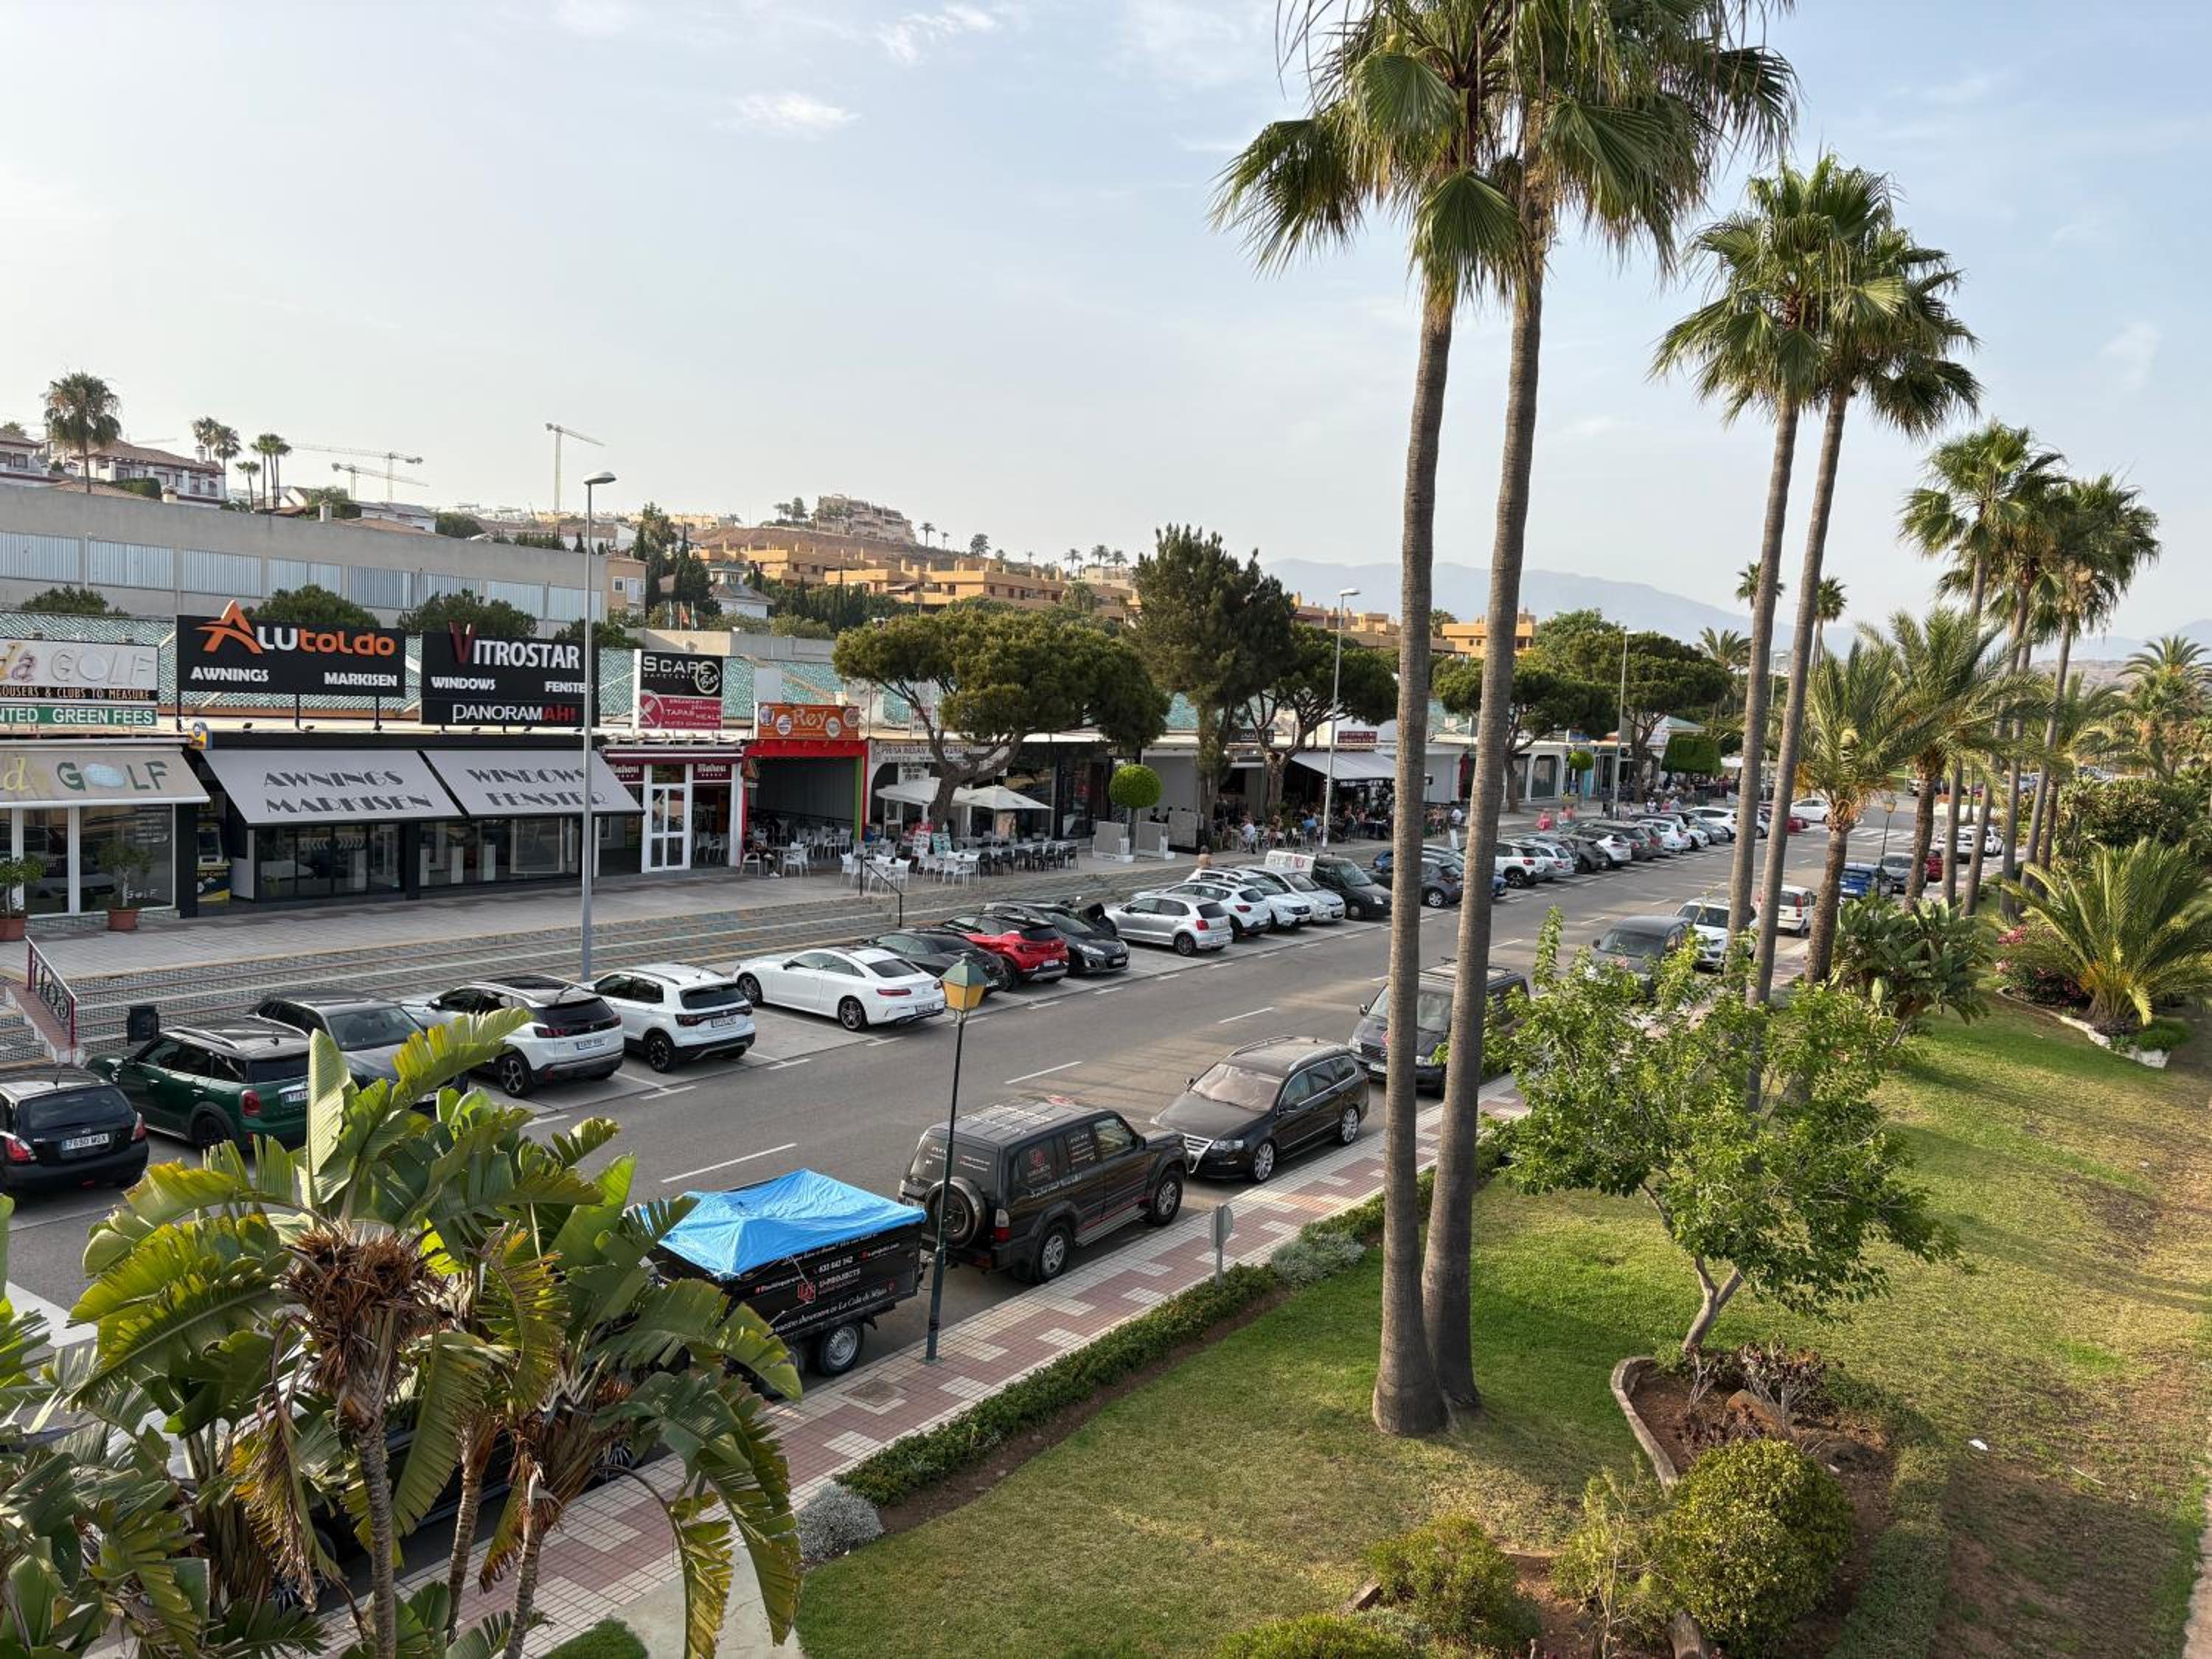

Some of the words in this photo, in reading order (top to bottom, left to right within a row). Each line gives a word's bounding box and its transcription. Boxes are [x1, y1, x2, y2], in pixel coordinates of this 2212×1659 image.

[448, 619, 580, 669] VITROSTAR
[51, 648, 153, 686] GOLF
[190, 666, 270, 683] AWNINGS
[324, 672, 398, 687] MARKISEN
[431, 676, 496, 690] WINDOWS
[57, 689, 86, 699] CLUBS
[52, 709, 108, 724] GREEN
[113, 710, 153, 725] FEES
[792, 708, 829, 729] Rey
[57, 760, 169, 792] GOLF
[265, 771, 404, 787] AWNINGS
[265, 793, 434, 813] MARKISEN
